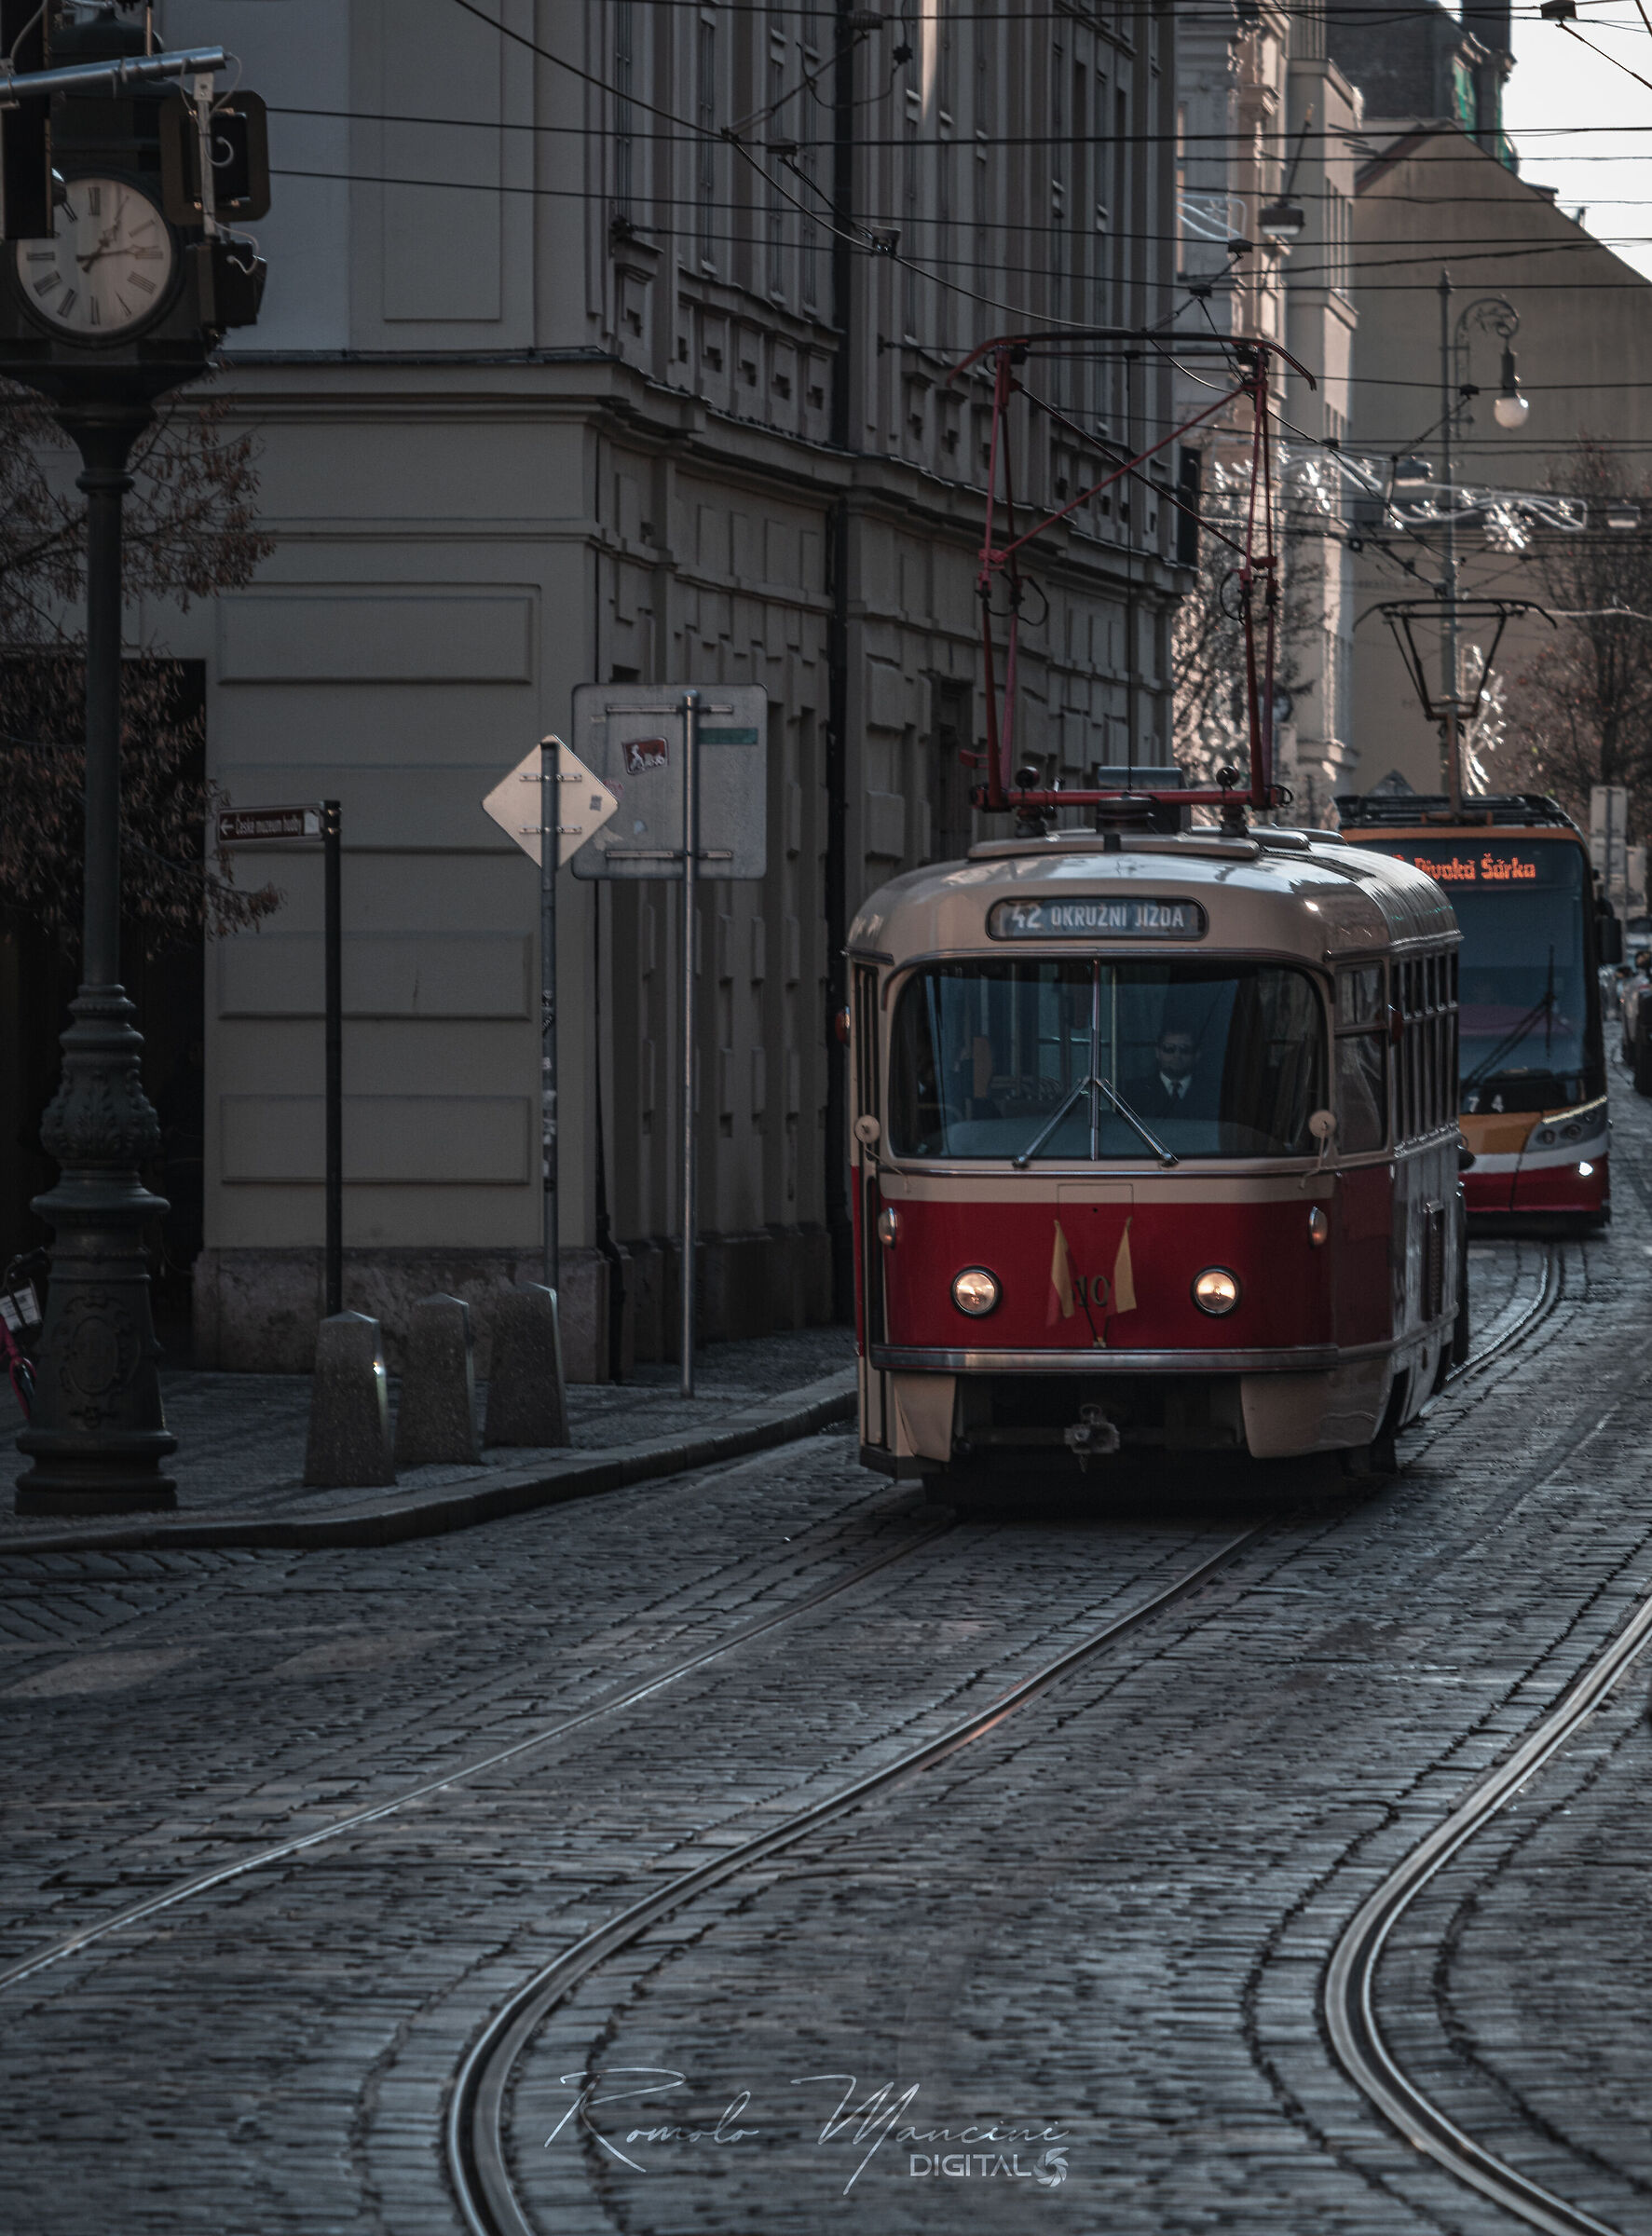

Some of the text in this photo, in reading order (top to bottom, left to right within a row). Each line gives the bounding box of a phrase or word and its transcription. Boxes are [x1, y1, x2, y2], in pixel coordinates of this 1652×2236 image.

[1481, 850, 1536, 880] Šárka
[1012, 902, 1184, 928] 42 OKRUŽNÍ JÍZDA
